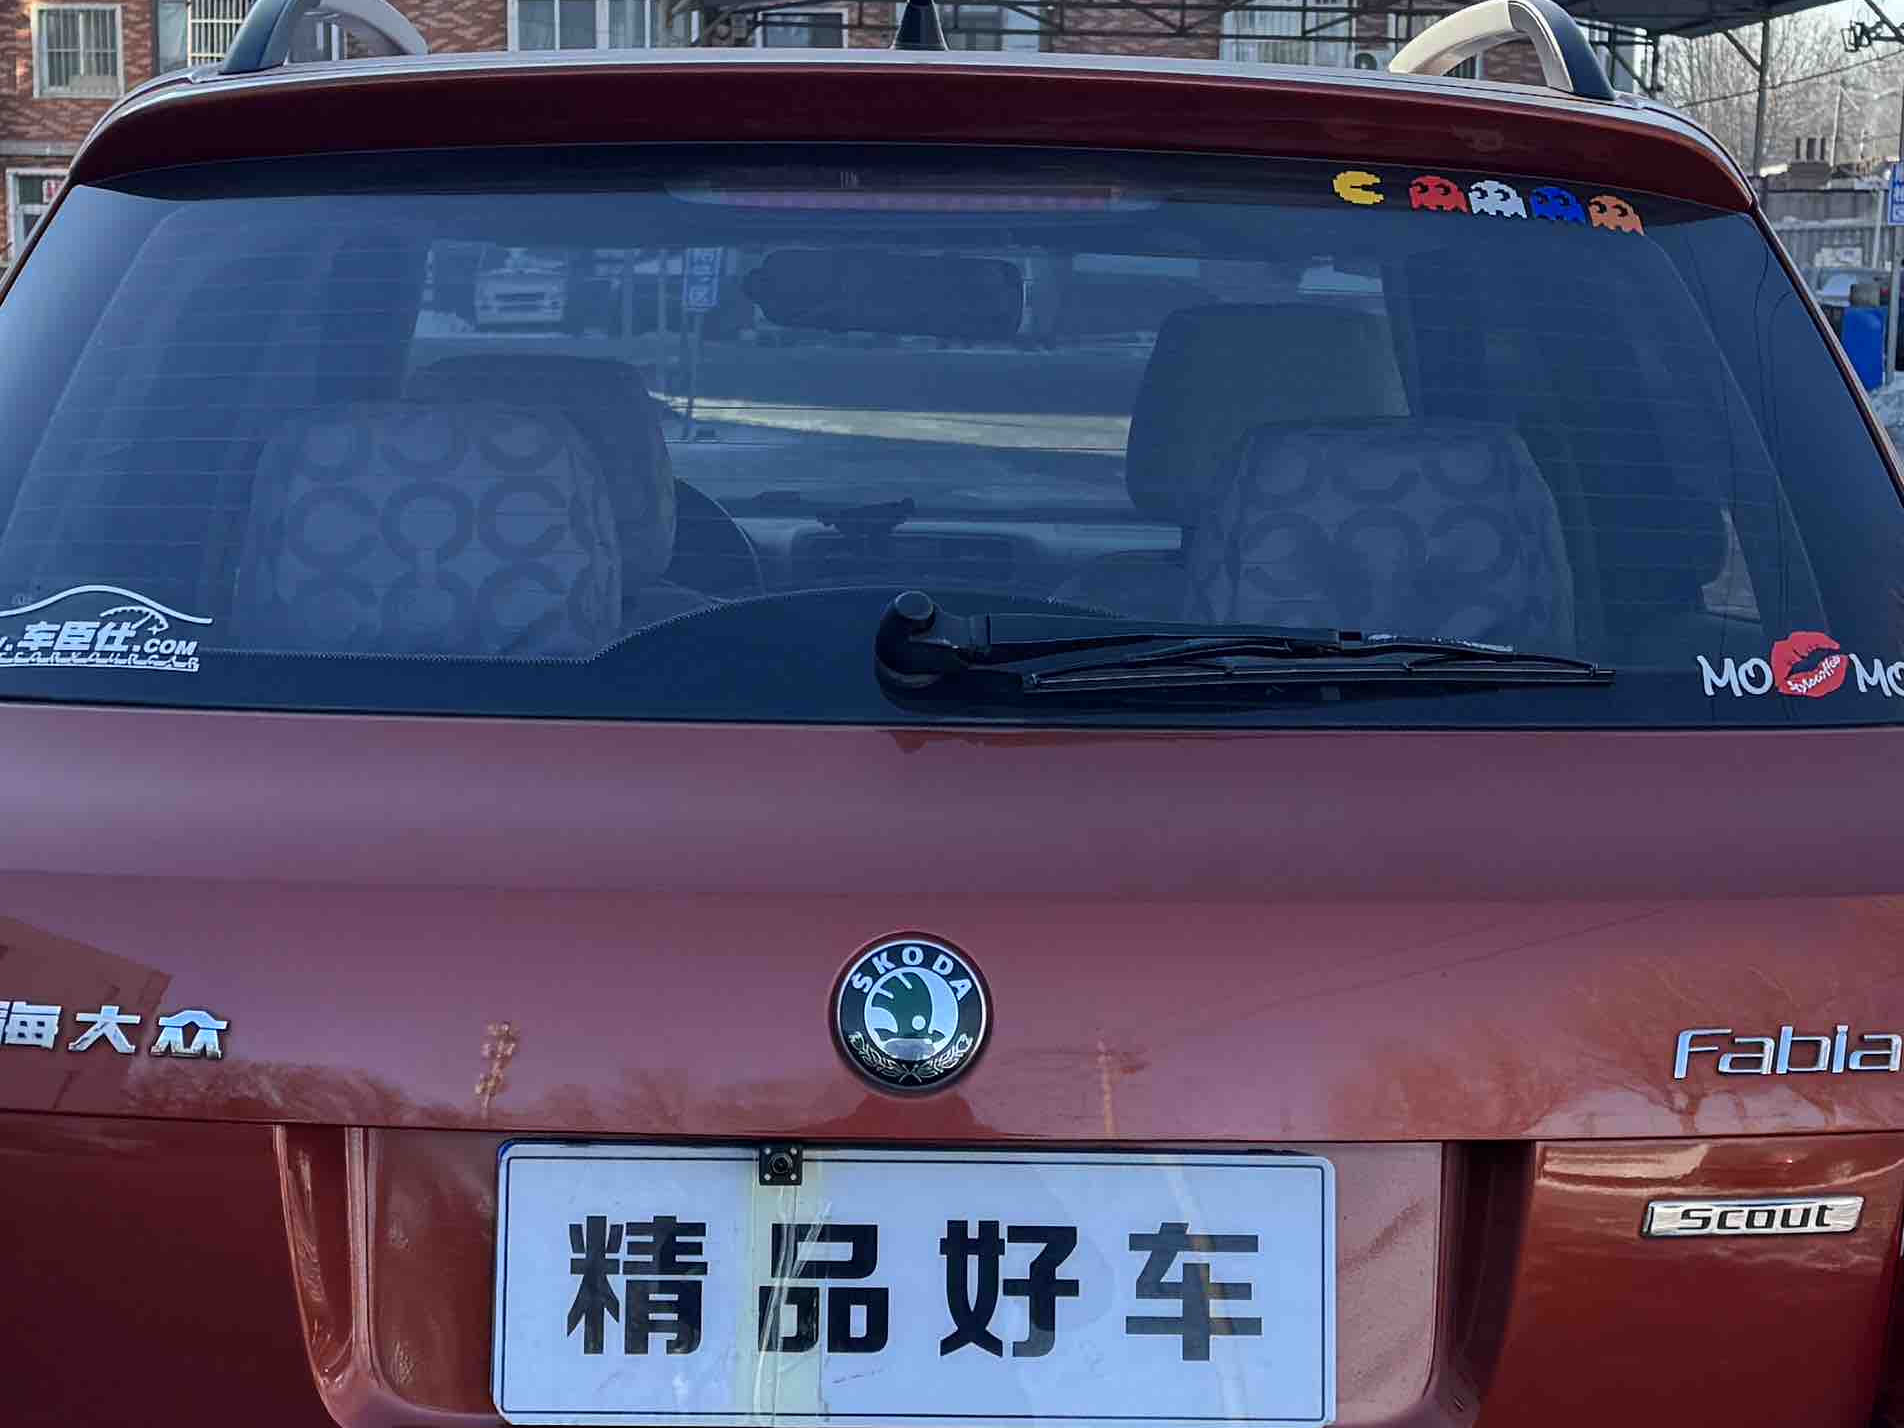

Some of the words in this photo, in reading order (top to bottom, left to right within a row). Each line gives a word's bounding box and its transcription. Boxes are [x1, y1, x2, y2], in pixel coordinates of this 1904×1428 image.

[1696, 654, 1774, 698] MO
[1673, 1025, 1903, 1080] Fabia
[566, 1214, 1264, 1362] 精品好车
